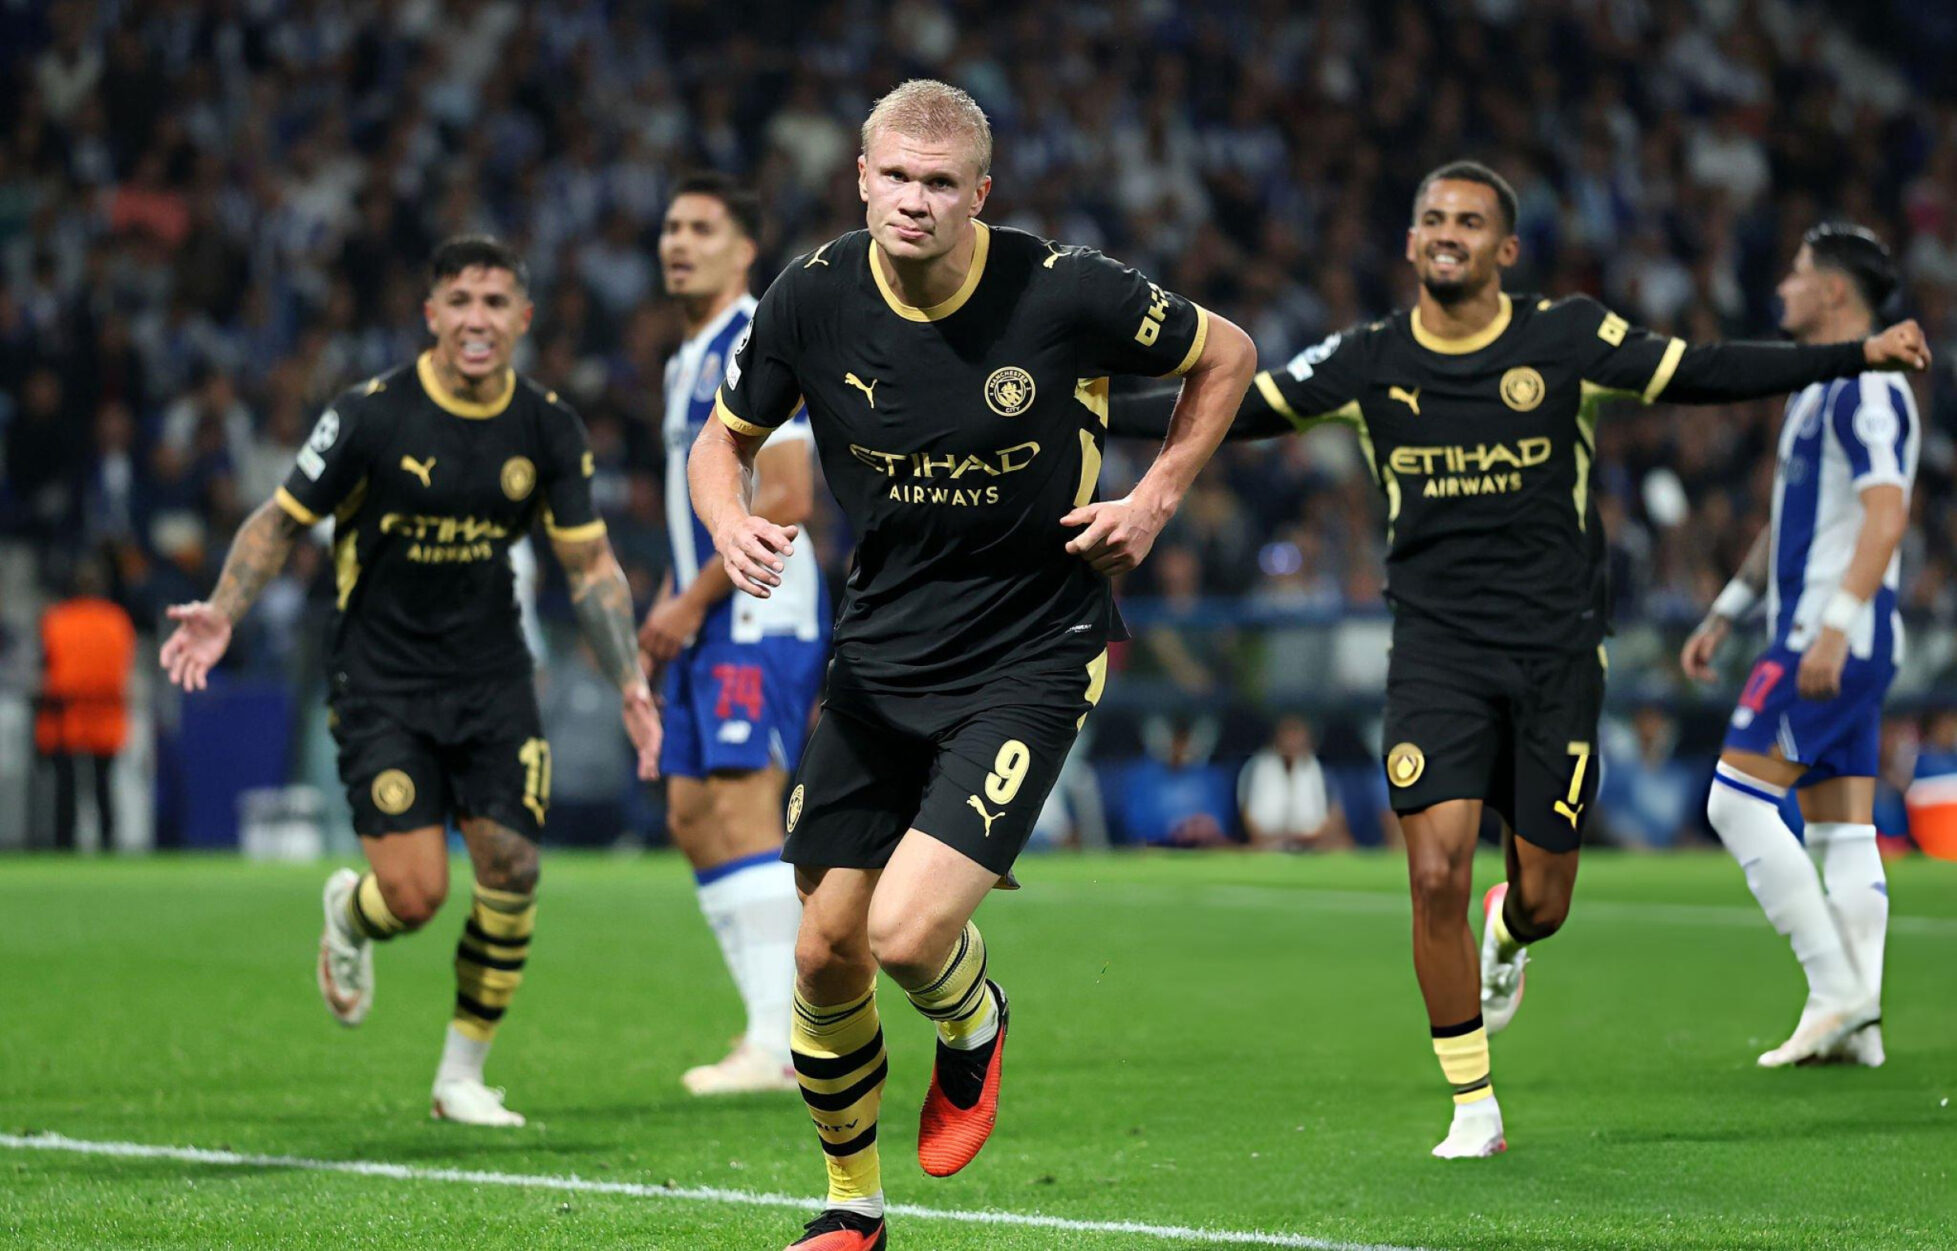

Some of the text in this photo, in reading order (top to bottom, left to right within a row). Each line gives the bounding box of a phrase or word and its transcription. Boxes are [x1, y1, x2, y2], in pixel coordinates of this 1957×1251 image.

[989, 370, 1028, 388] MANCHESTER
[850, 441, 1041, 479] ETIHAD
[1390, 437, 1551, 474] ETIHAD
[889, 485, 1000, 506] AIRWAYS
[1423, 472, 1522, 498] AIRWAYS
[985, 739, 1030, 805] 9
[1567, 742, 1590, 804] 7
